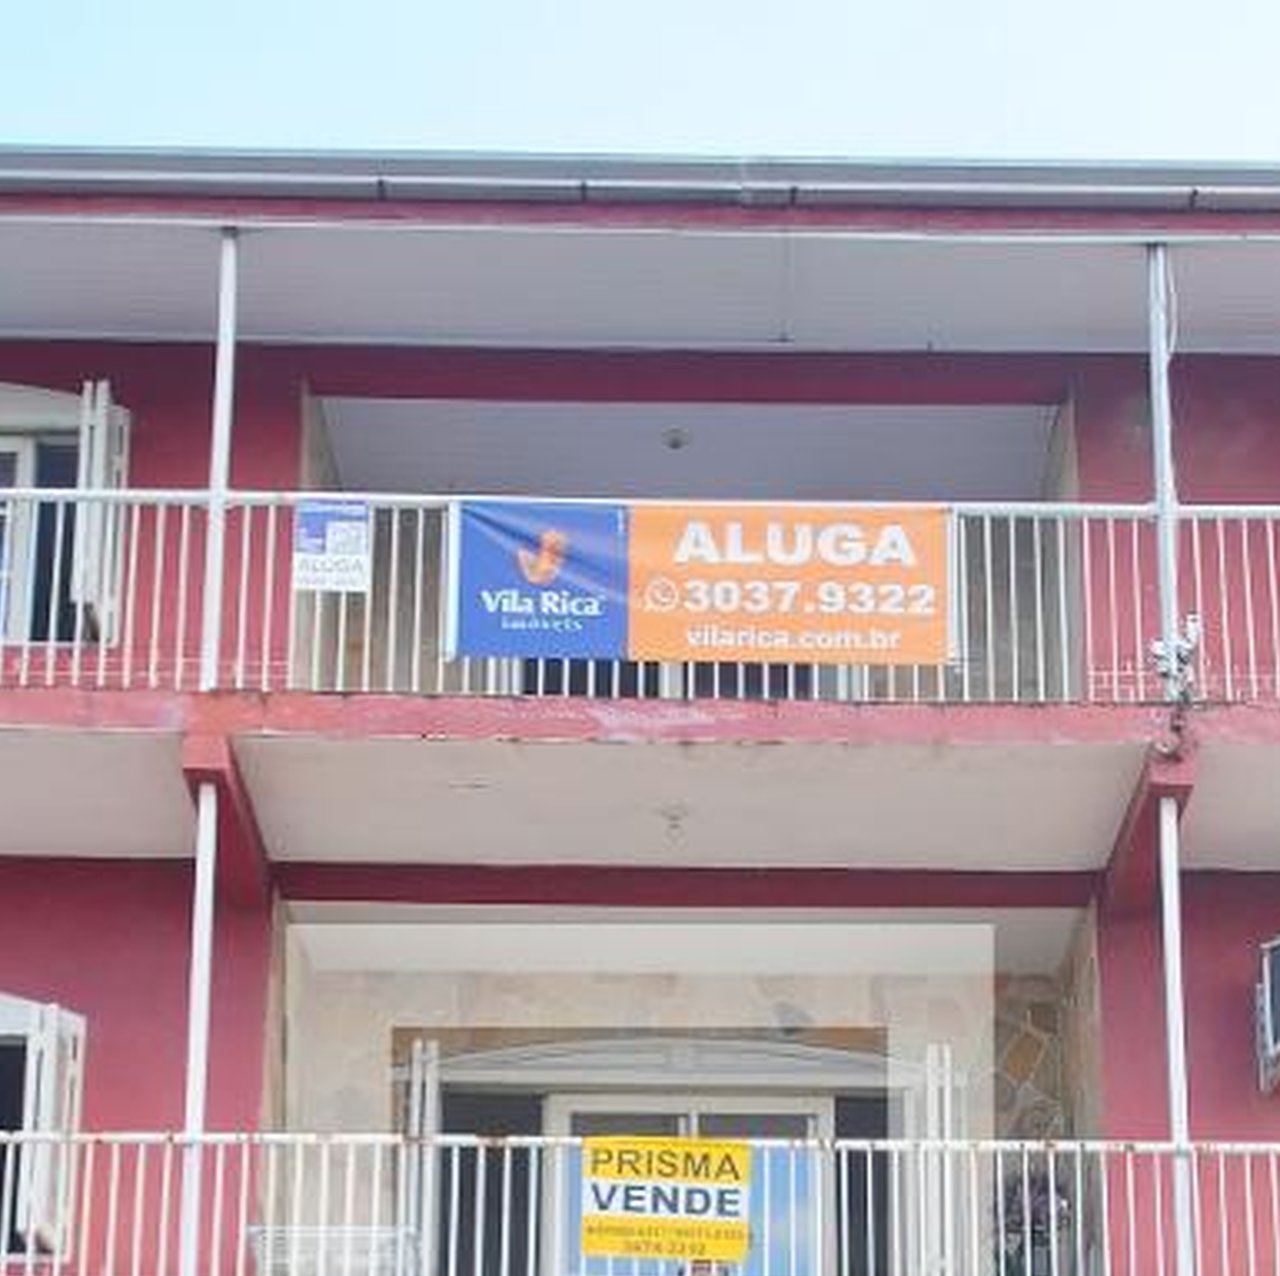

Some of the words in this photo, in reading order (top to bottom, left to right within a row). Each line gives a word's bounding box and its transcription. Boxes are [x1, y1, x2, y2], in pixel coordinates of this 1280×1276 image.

[674, 521, 917, 566] ALUGA
[480, 588, 534, 613] Vila
[540, 589, 603, 616] Rica
[683, 579, 935, 614] 3037.9322
[687, 623, 901, 649] vilarica.com.br
[590, 1147, 740, 1181] PRISMA
[591, 1183, 741, 1217] VENDE
